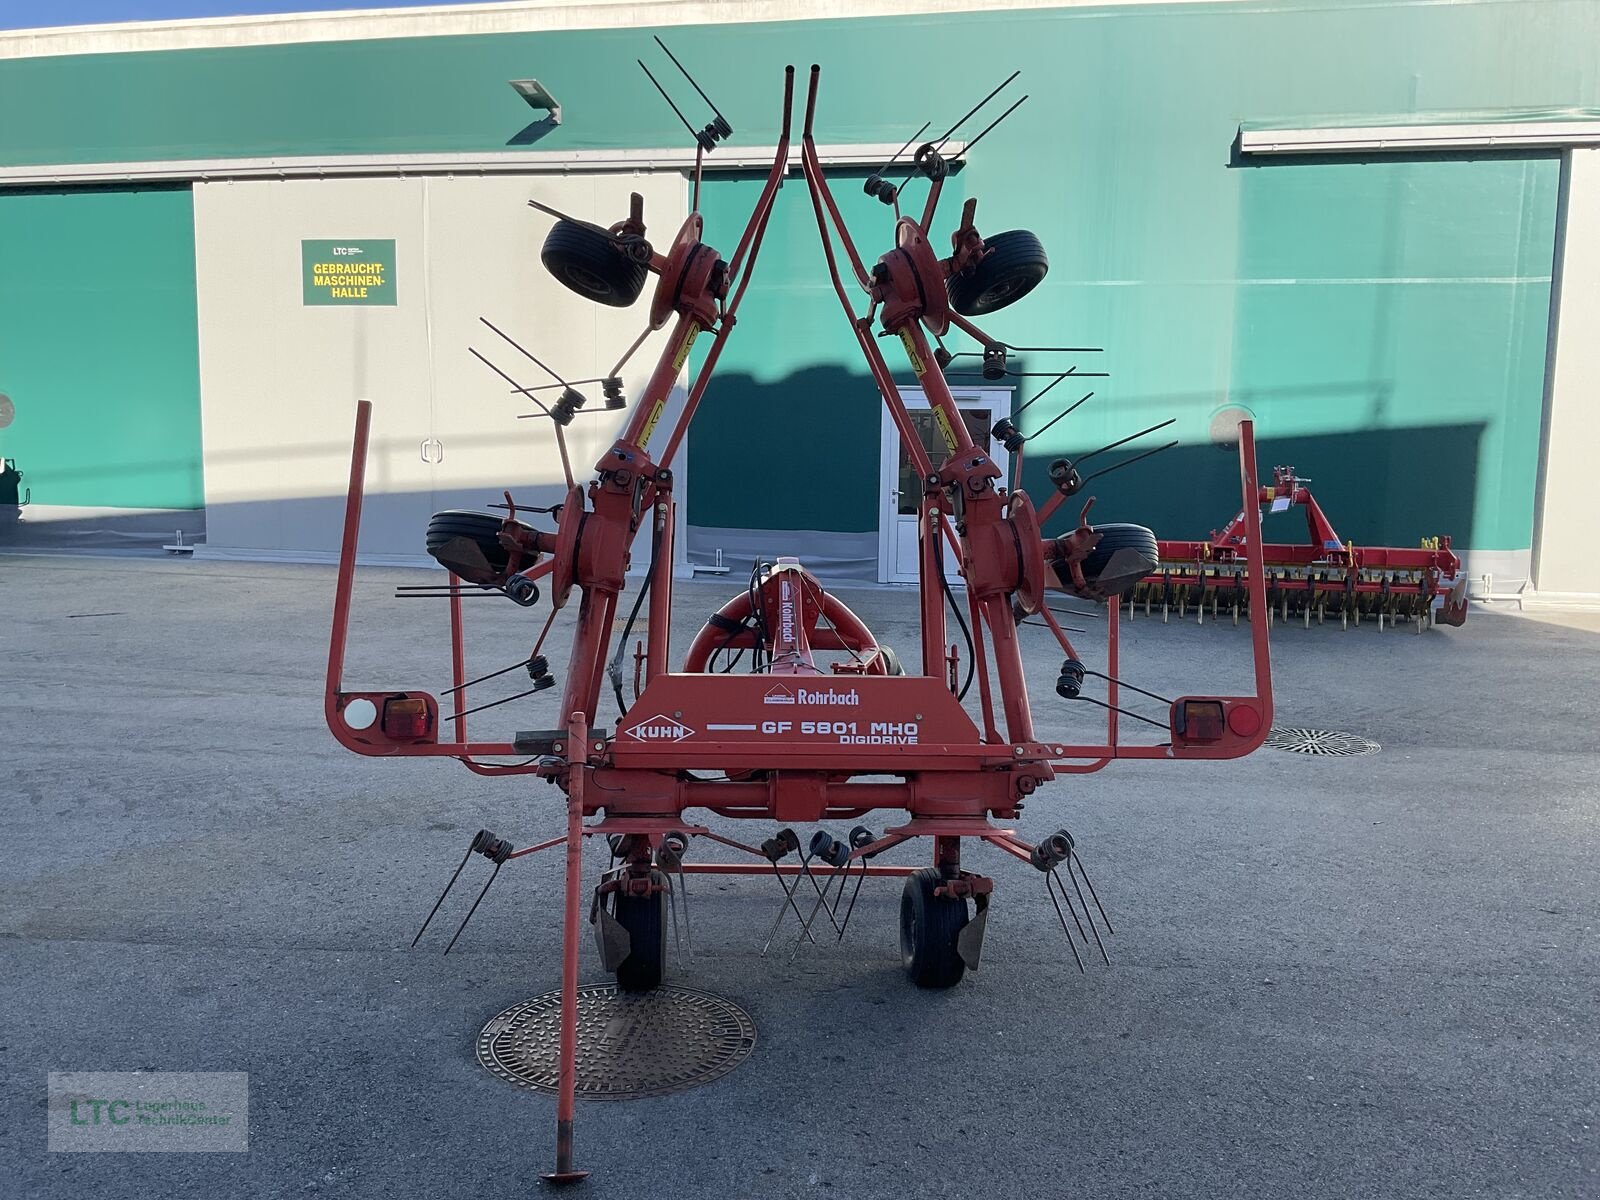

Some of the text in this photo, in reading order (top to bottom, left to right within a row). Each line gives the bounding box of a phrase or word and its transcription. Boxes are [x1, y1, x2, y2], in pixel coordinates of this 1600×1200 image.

[333, 247, 347, 255] LTC
[313, 263, 385, 274] GEBRAUCHT-
[314, 275, 386, 286] MASCHINEN-
[332, 287, 368, 298] HALLE
[797, 688, 859, 706] Rohrbach
[636, 726, 684, 738] KUHN
[761, 721, 918, 736] GF 5801 MHO
[839, 735, 919, 745] DIGIDRIVE
